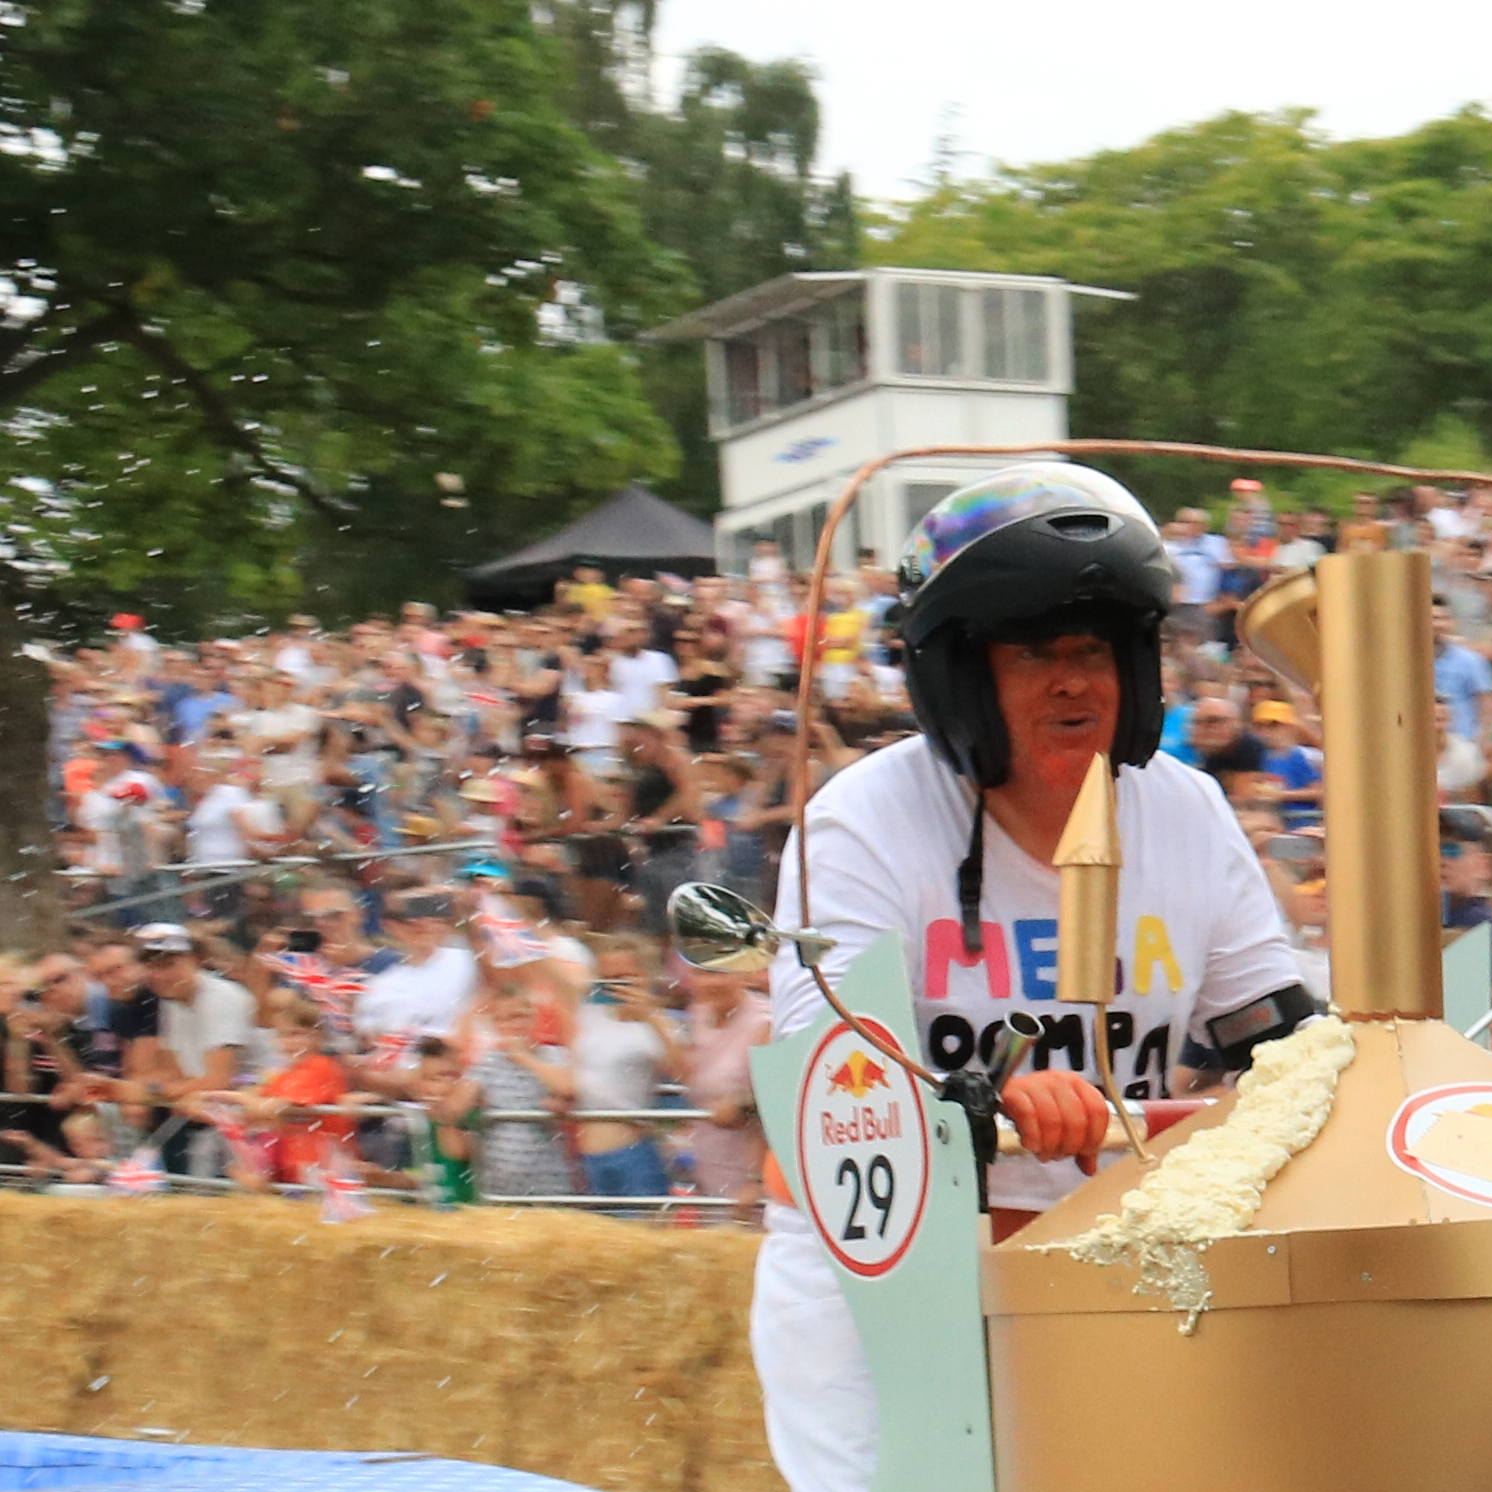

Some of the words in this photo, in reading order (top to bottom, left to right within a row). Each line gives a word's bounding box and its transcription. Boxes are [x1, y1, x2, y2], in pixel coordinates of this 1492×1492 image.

[925, 915, 1184, 1000] MEA
[821, 1105, 859, 1146] Red
[862, 1101, 902, 1141] Bull
[836, 1154, 894, 1240] 29
